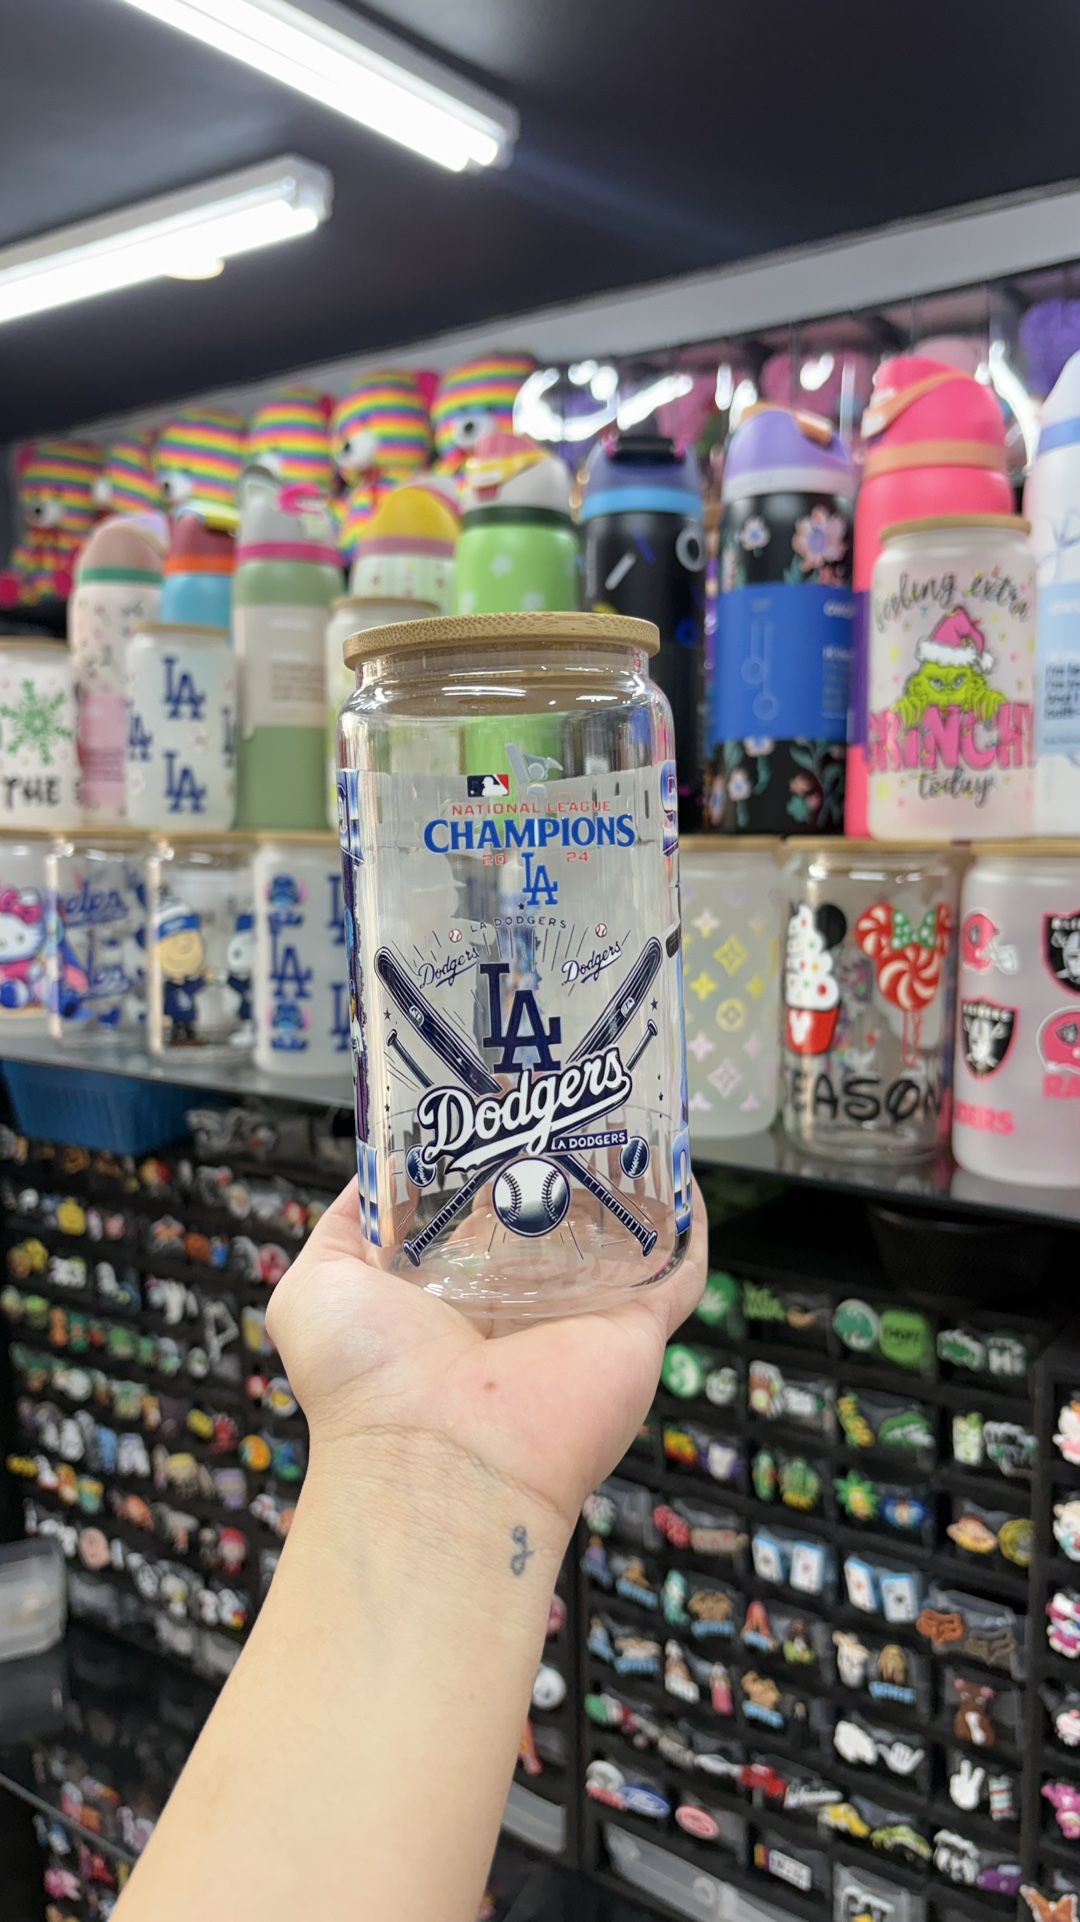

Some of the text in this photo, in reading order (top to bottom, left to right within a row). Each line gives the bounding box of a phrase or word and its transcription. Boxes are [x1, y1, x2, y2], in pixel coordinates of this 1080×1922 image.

[162, 656, 206, 720] LA
[5, 774, 60, 812] THE
[163, 751, 206, 814] LA
[919, 767, 993, 809] today
[452, 801, 611, 816] NATIONAL LEAGUE
[423, 814, 635, 853] CHAMPIONS
[481, 852, 590, 866] 20 24
[521, 852, 558, 905] LA
[470, 916, 567, 933] LA DODGERS
[419, 947, 479, 989] Dodgers
[561, 941, 623, 986] Dodgers
[480, 963, 562, 1073] LA
[418, 1048, 632, 1172] Dodgers
[551, 1132, 626, 1150] LA DODGERS
